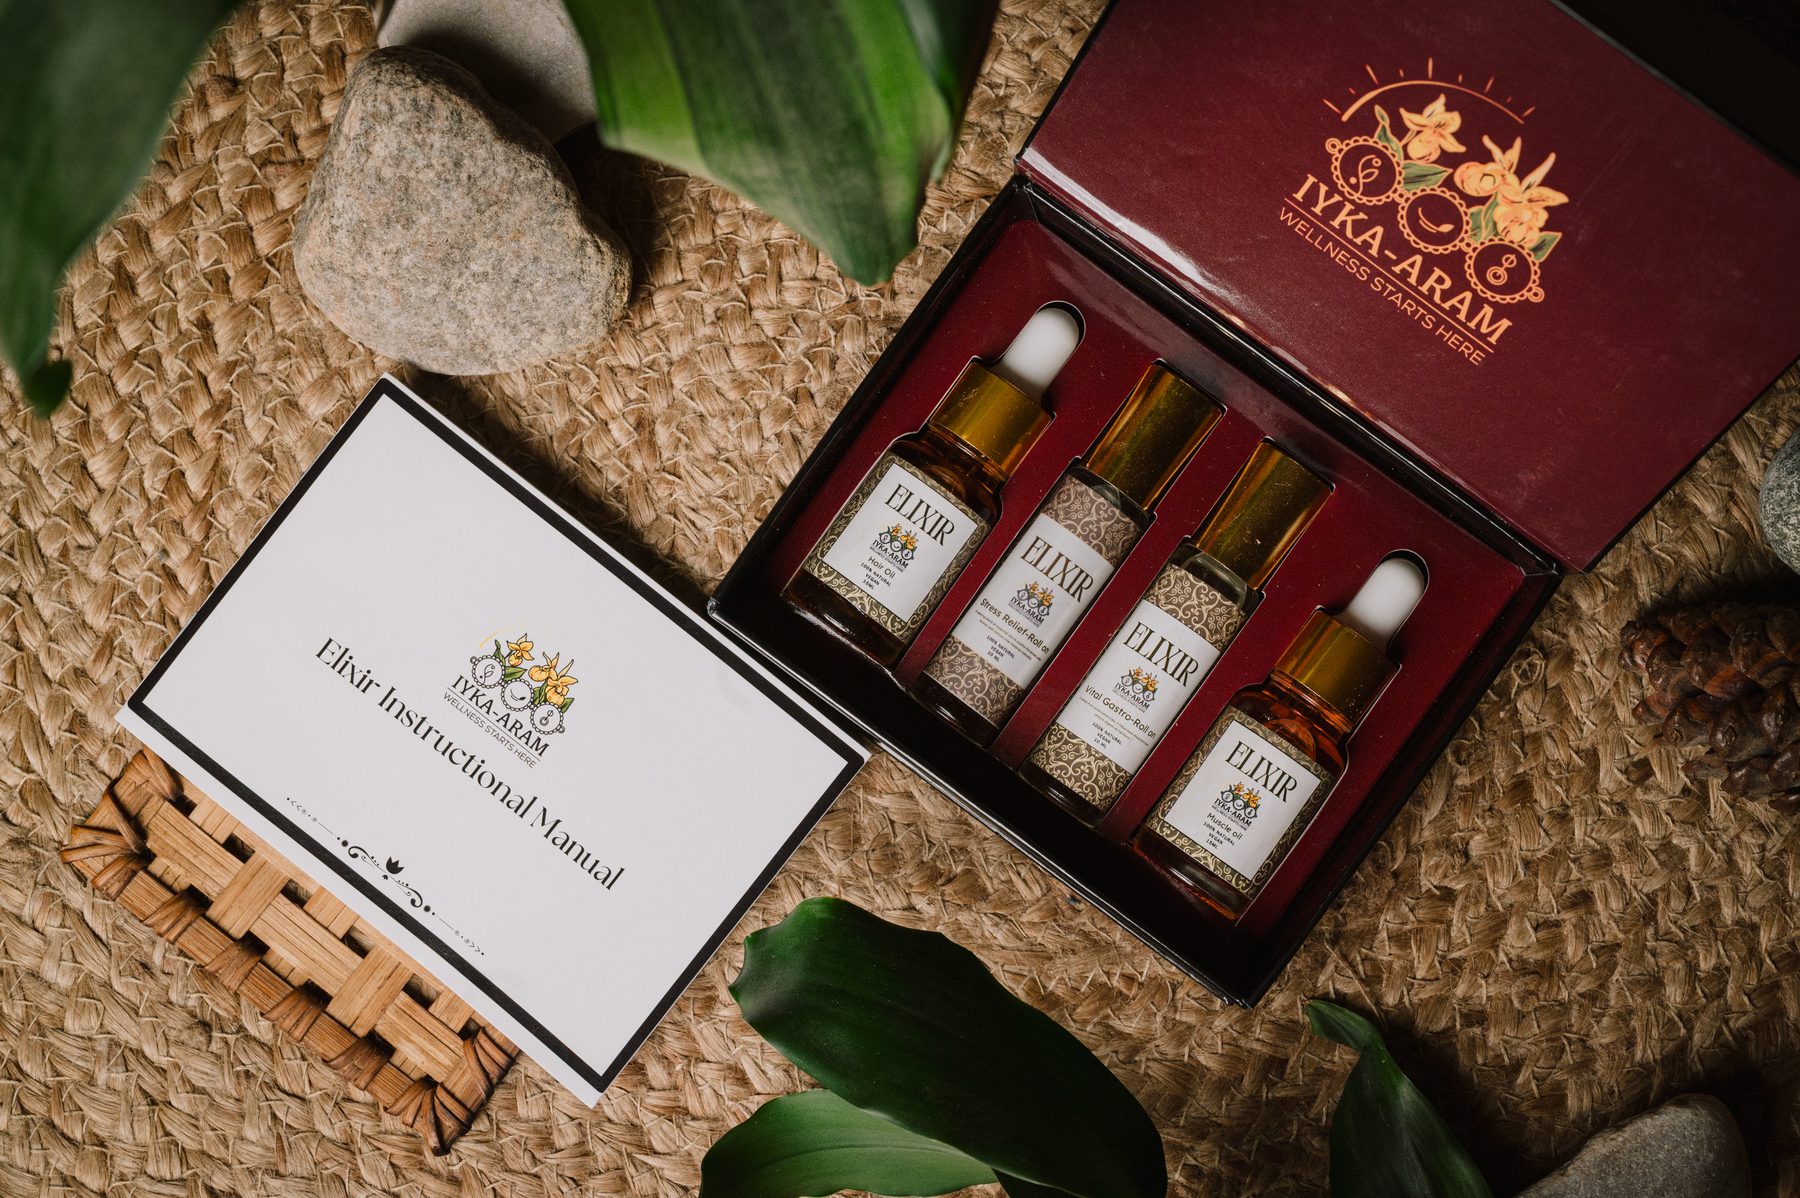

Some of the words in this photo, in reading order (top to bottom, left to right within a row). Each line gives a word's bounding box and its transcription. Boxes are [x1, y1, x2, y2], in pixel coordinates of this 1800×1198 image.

[1293, 174, 1512, 345] IYKA-ARAM
[1279, 207, 1371, 284] WELLNESS
[1370, 277, 1436, 330] STARTS
[1435, 325, 1486, 366] HERE
[884, 483, 955, 546] ELIXIR
[868, 556, 885, 571] Hair
[884, 568, 896, 579] Oil
[873, 540, 909, 569] IYKA-ARAM
[861, 563, 873, 573] 100%
[873, 572, 892, 587] NATURAL
[865, 574, 880, 586] VEGAN
[1020, 536, 1094, 603] ELIXIR
[1011, 597, 1045, 624] IYKA-ARAM
[980, 598, 1003, 618] Stress
[1001, 614, 1044, 648] Relief-Roll
[1041, 645, 1050, 654] on
[986, 636, 998, 646] 100%
[998, 644, 1016, 659] NATURAL
[990, 646, 1004, 658] VEGAN
[1123, 621, 1199, 687] ELIXIR
[1115, 682, 1150, 710] IYKA-ARAM
[451, 674, 550, 758] IYKA-ARAM
[1085, 685, 1103, 701] Vital
[1102, 696, 1149, 734] Gastro-Roll
[1147, 730, 1156, 739] on
[443, 692, 485, 728] WELLNESS
[485, 725, 513, 751] STARTS
[513, 748, 536, 769] HERE
[1092, 722, 1104, 732] 100%
[1104, 730, 1122, 745] NATURAL
[1097, 733, 1111, 744] VEGAN
[315, 637, 381, 695] Elixir
[377, 685, 538, 819] Instructional
[529, 805, 626, 890] Manual
[1225, 740, 1297, 803] ELIXIR
[1207, 812, 1233, 834] Muscle
[1232, 830, 1243, 840] oil
[1215, 798, 1252, 827] IYKA-ARAM
[1204, 822, 1216, 832] 100%
[1216, 830, 1236, 846] NATURAL
[1209, 833, 1224, 845] VEGAN
